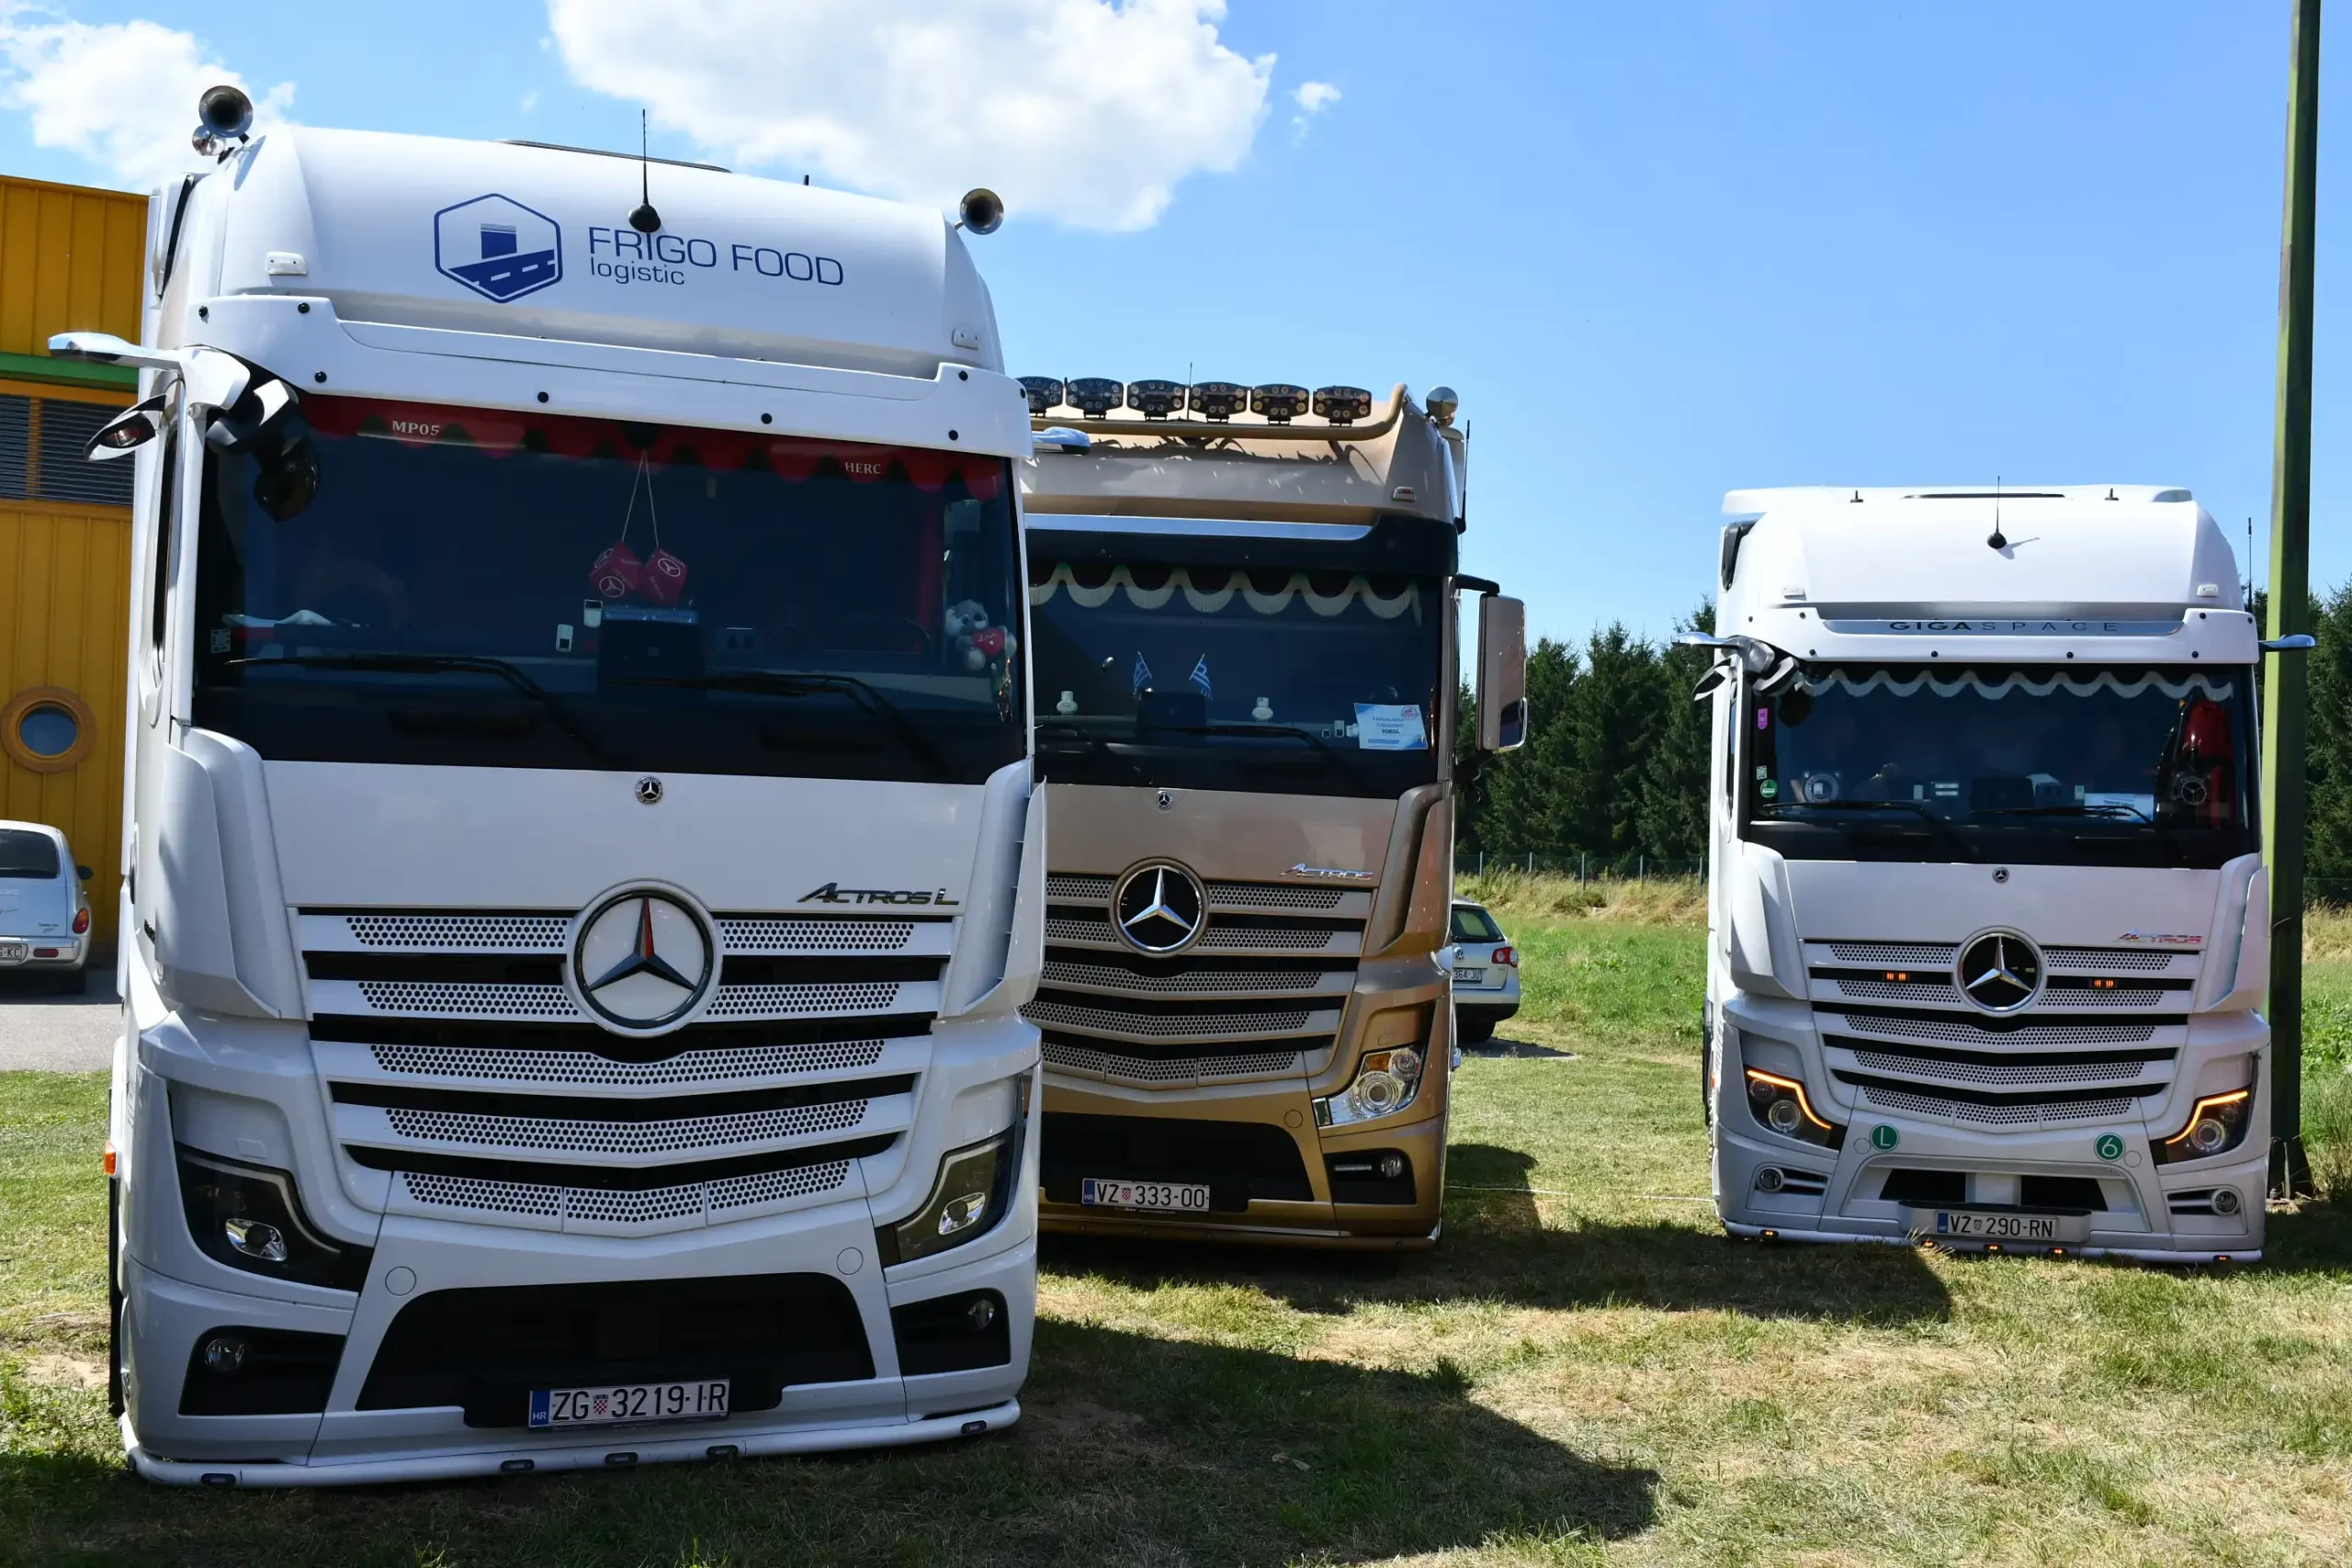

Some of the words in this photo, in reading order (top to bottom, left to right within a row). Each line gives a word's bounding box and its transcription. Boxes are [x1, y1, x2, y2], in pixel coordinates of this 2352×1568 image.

[588, 226, 717, 268] FRIGO
[731, 243, 844, 287] FOOD
[590, 256, 685, 286] logistic
[391, 420, 441, 436] MP05
[844, 461, 882, 475] HERC
[1279, 863, 1374, 881] ACTROS
[797, 882, 933, 905] ACTROS
[1880, 1128, 1891, 1148] L
[2102, 1137, 2118, 1157] 6
[1096, 1183, 1119, 1203] VZ
[1135, 1185, 1205, 1208] 333-00
[1950, 1215, 1972, 1234] VZ
[1985, 1217, 2052, 1237] 290-RN
[532, 1411, 547, 1421] HR
[553, 1391, 589, 1420] ZG
